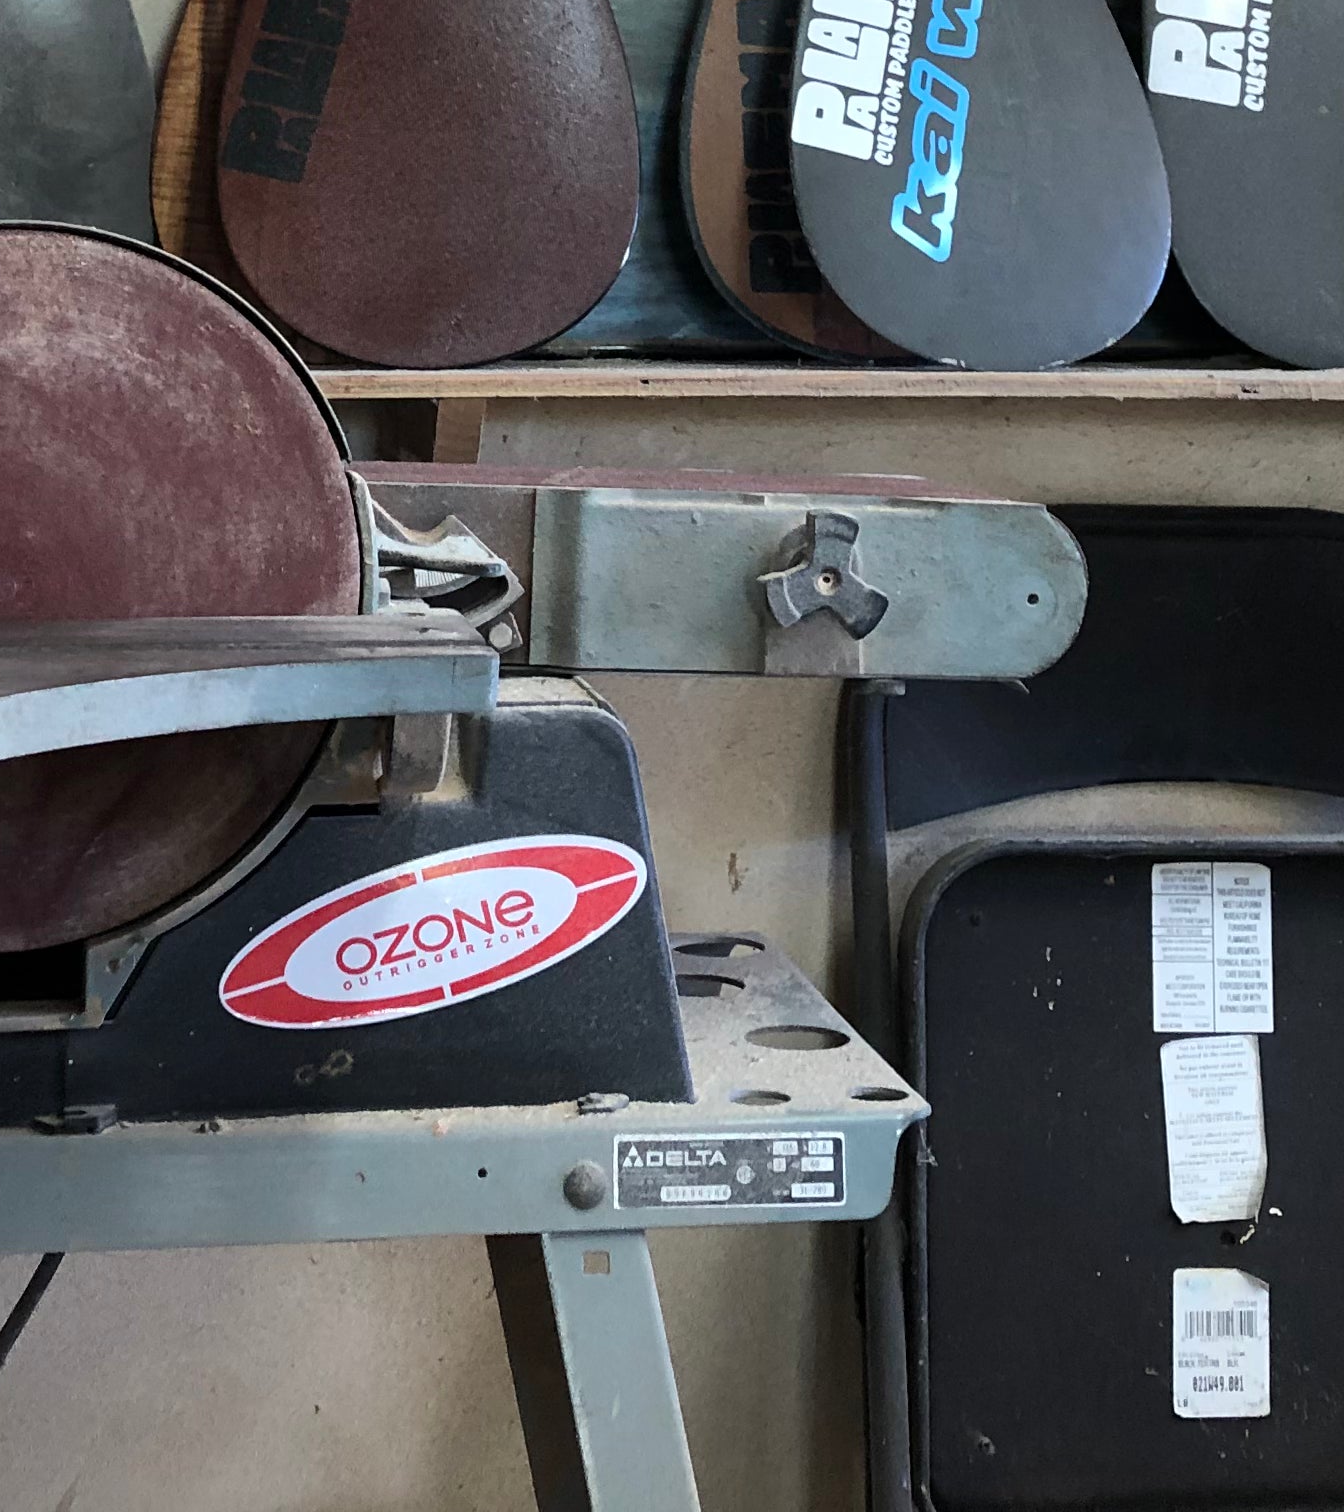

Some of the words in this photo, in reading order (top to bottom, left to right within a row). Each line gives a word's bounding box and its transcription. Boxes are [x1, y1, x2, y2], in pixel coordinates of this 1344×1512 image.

[1243, 9, 1273, 113] CUSTOM
[874, 79, 905, 166] CUSTOM
[891, 58, 971, 262] kai
[646, 1149, 727, 1167] DELTA
